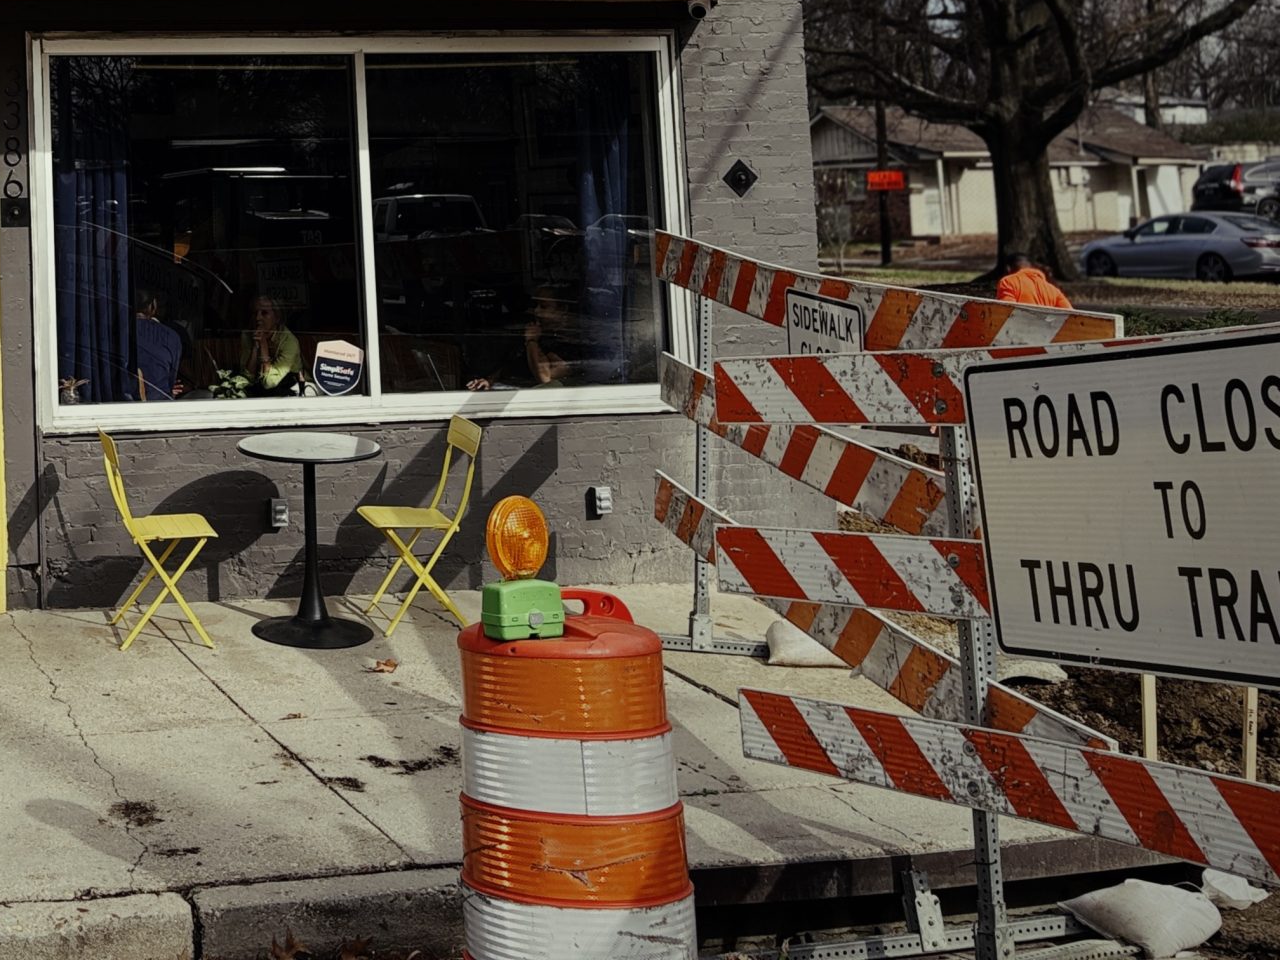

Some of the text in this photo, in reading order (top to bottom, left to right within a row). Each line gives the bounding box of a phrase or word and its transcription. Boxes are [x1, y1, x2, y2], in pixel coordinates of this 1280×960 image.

[792, 302, 854, 344] SIDEWALK
[320, 363, 355, 376] SimpliSafe
[1003, 391, 1120, 458] ROAD
[1153, 480, 1206, 540] TO
[1020, 559, 1280, 645] THRU TRA
